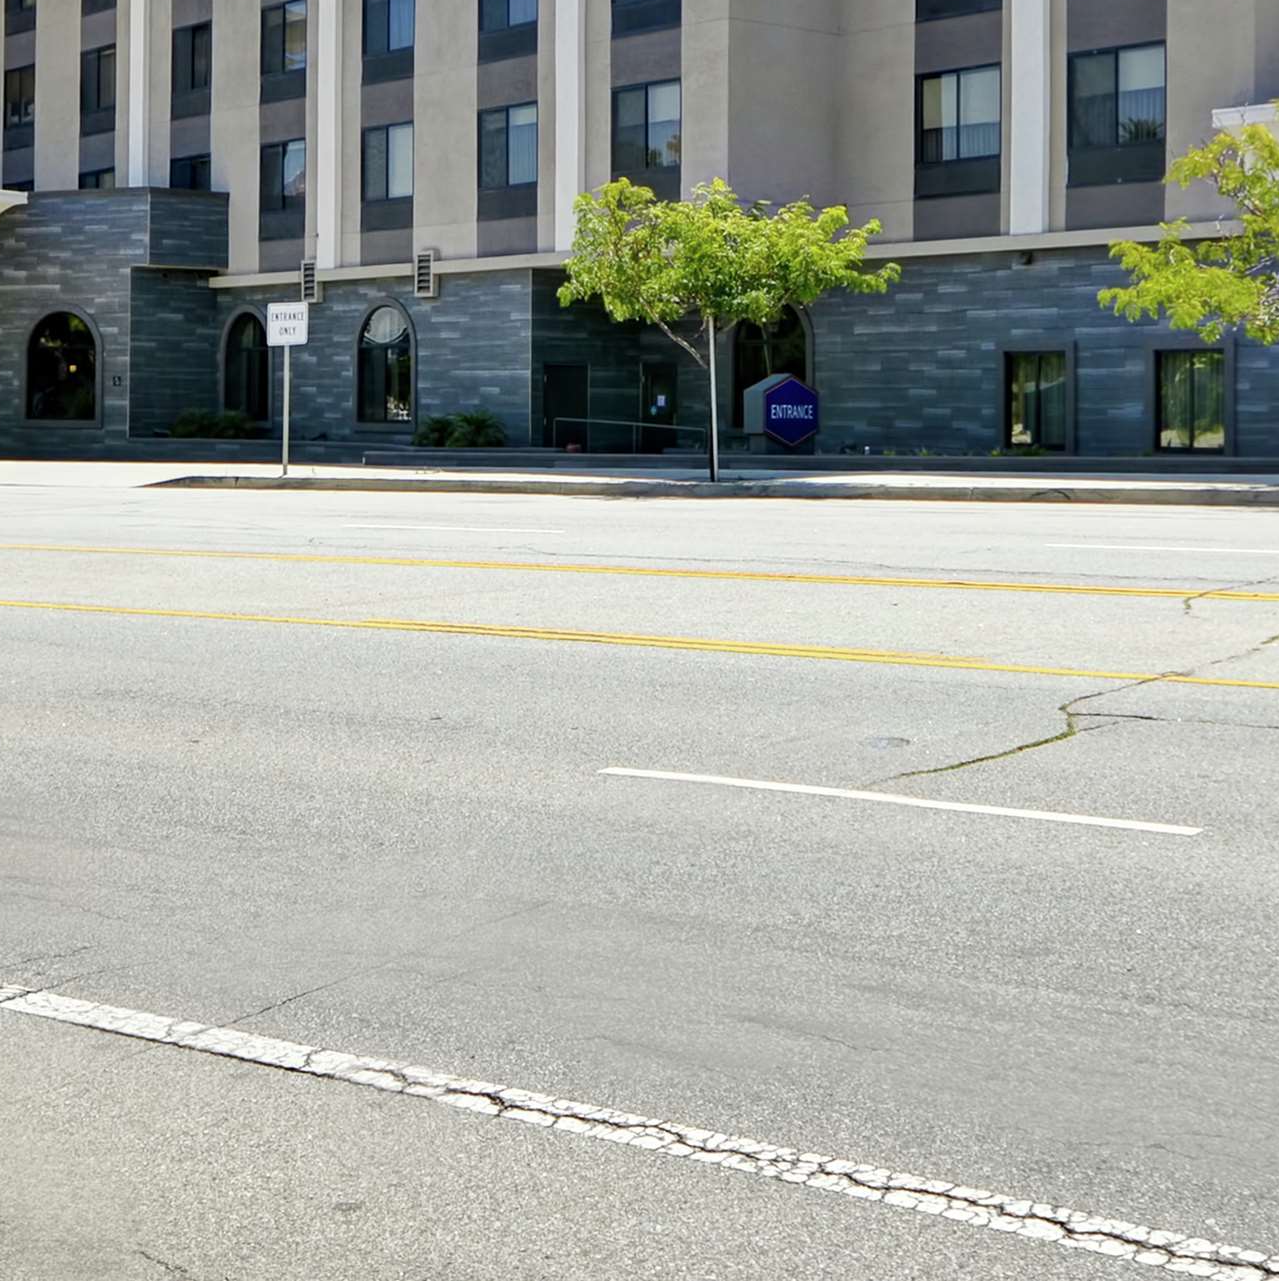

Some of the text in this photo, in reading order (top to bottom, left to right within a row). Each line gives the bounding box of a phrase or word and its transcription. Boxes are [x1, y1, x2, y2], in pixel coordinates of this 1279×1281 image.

[271, 311, 305, 322] ENTRANCE
[279, 326, 297, 336] ONLY
[770, 404, 814, 420] ENTRANCE
